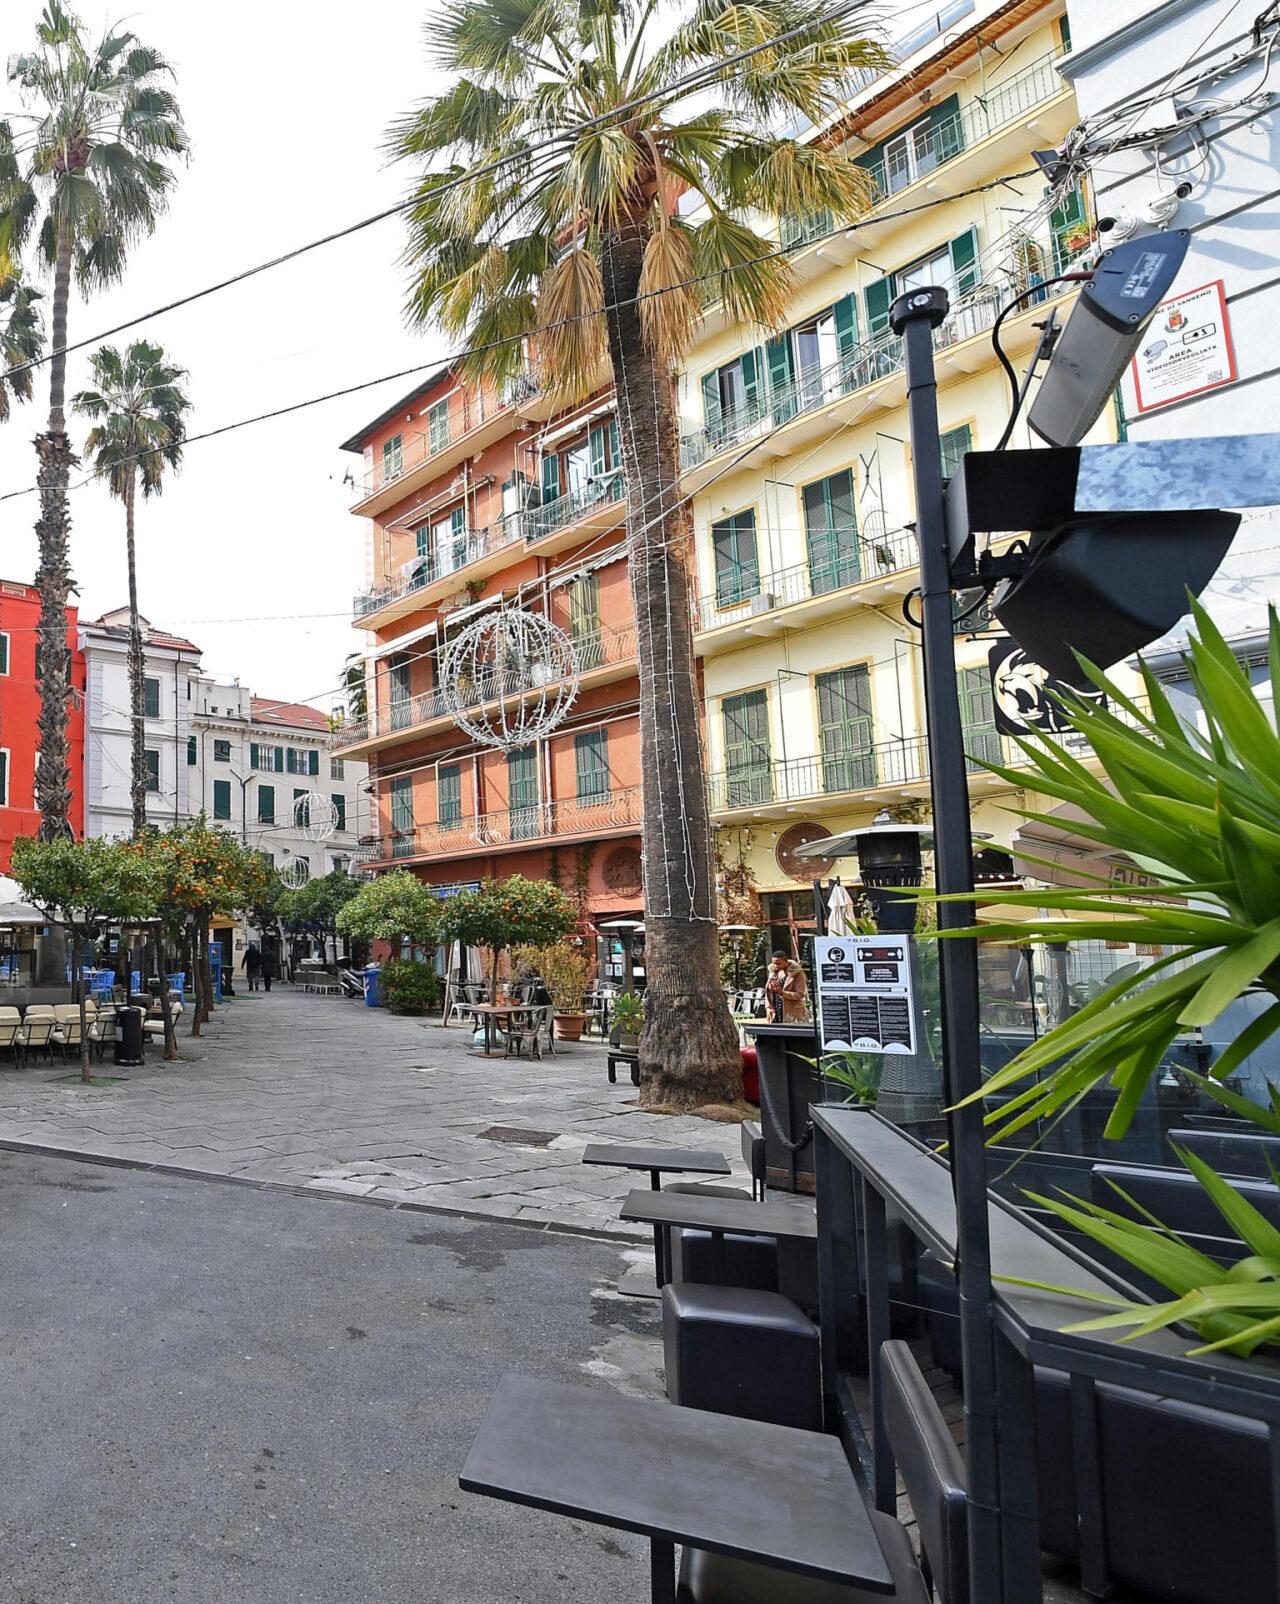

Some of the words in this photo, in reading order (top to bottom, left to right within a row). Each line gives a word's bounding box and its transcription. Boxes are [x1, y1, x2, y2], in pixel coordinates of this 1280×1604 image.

[1177, 290, 1212, 306] SANREMO
[1146, 345, 1217, 373] VIDEOSORVEGLIATA
[1169, 348, 1192, 360] AREA
